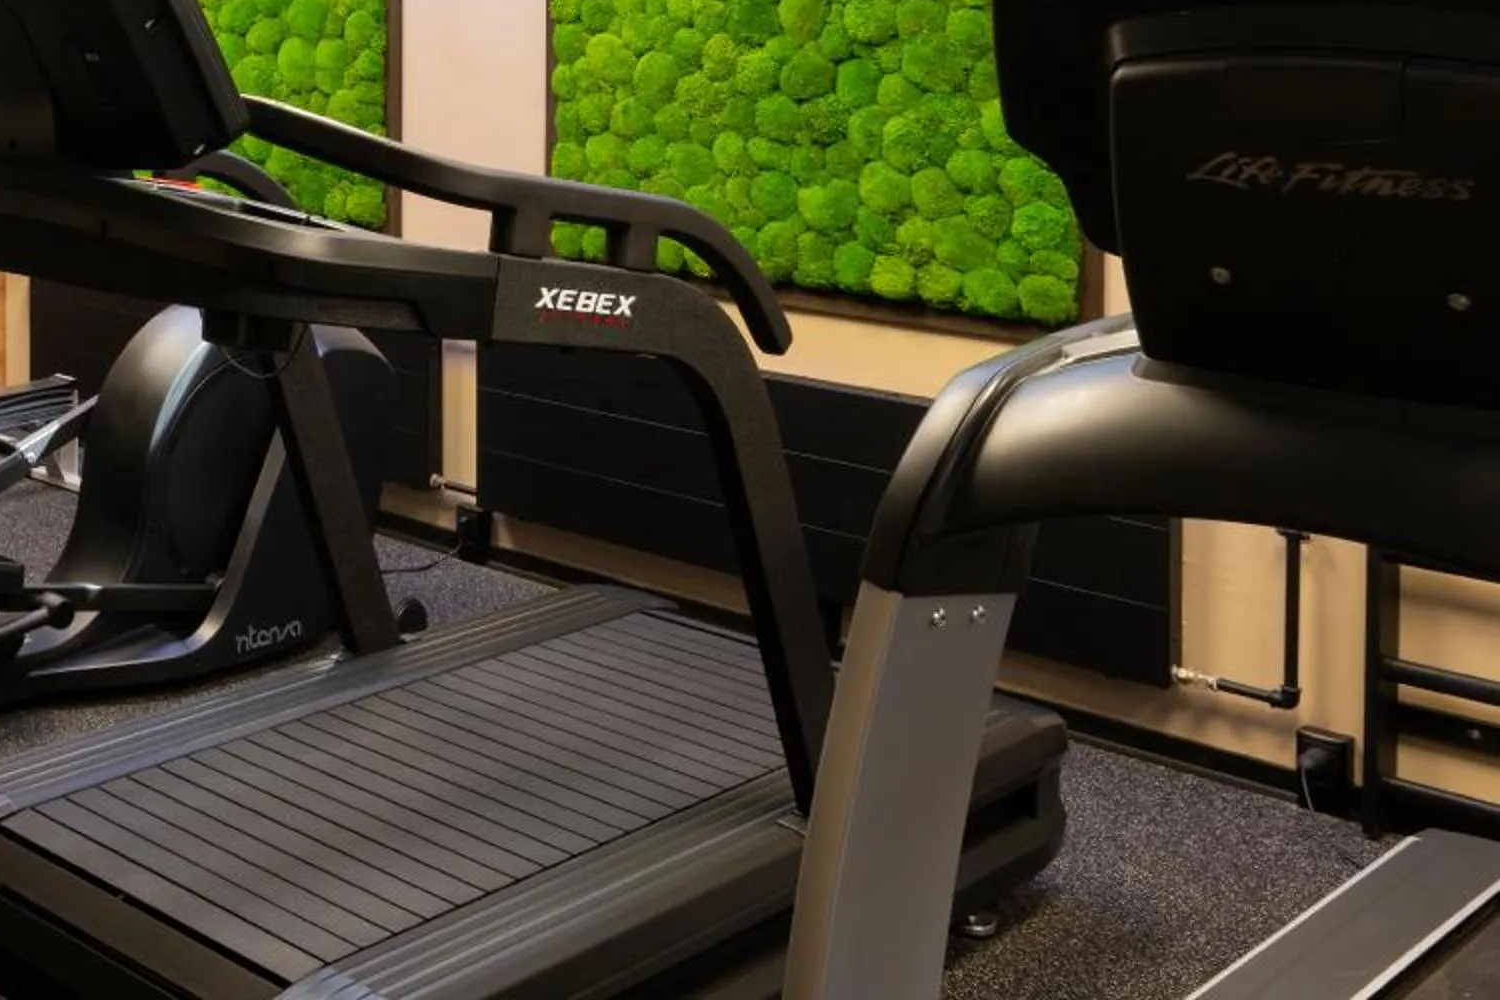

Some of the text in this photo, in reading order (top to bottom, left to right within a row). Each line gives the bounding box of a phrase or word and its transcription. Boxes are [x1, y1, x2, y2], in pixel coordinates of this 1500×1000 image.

[1185, 151, 1476, 201] Life Fitness
[534, 287, 637, 317] XEBEX
